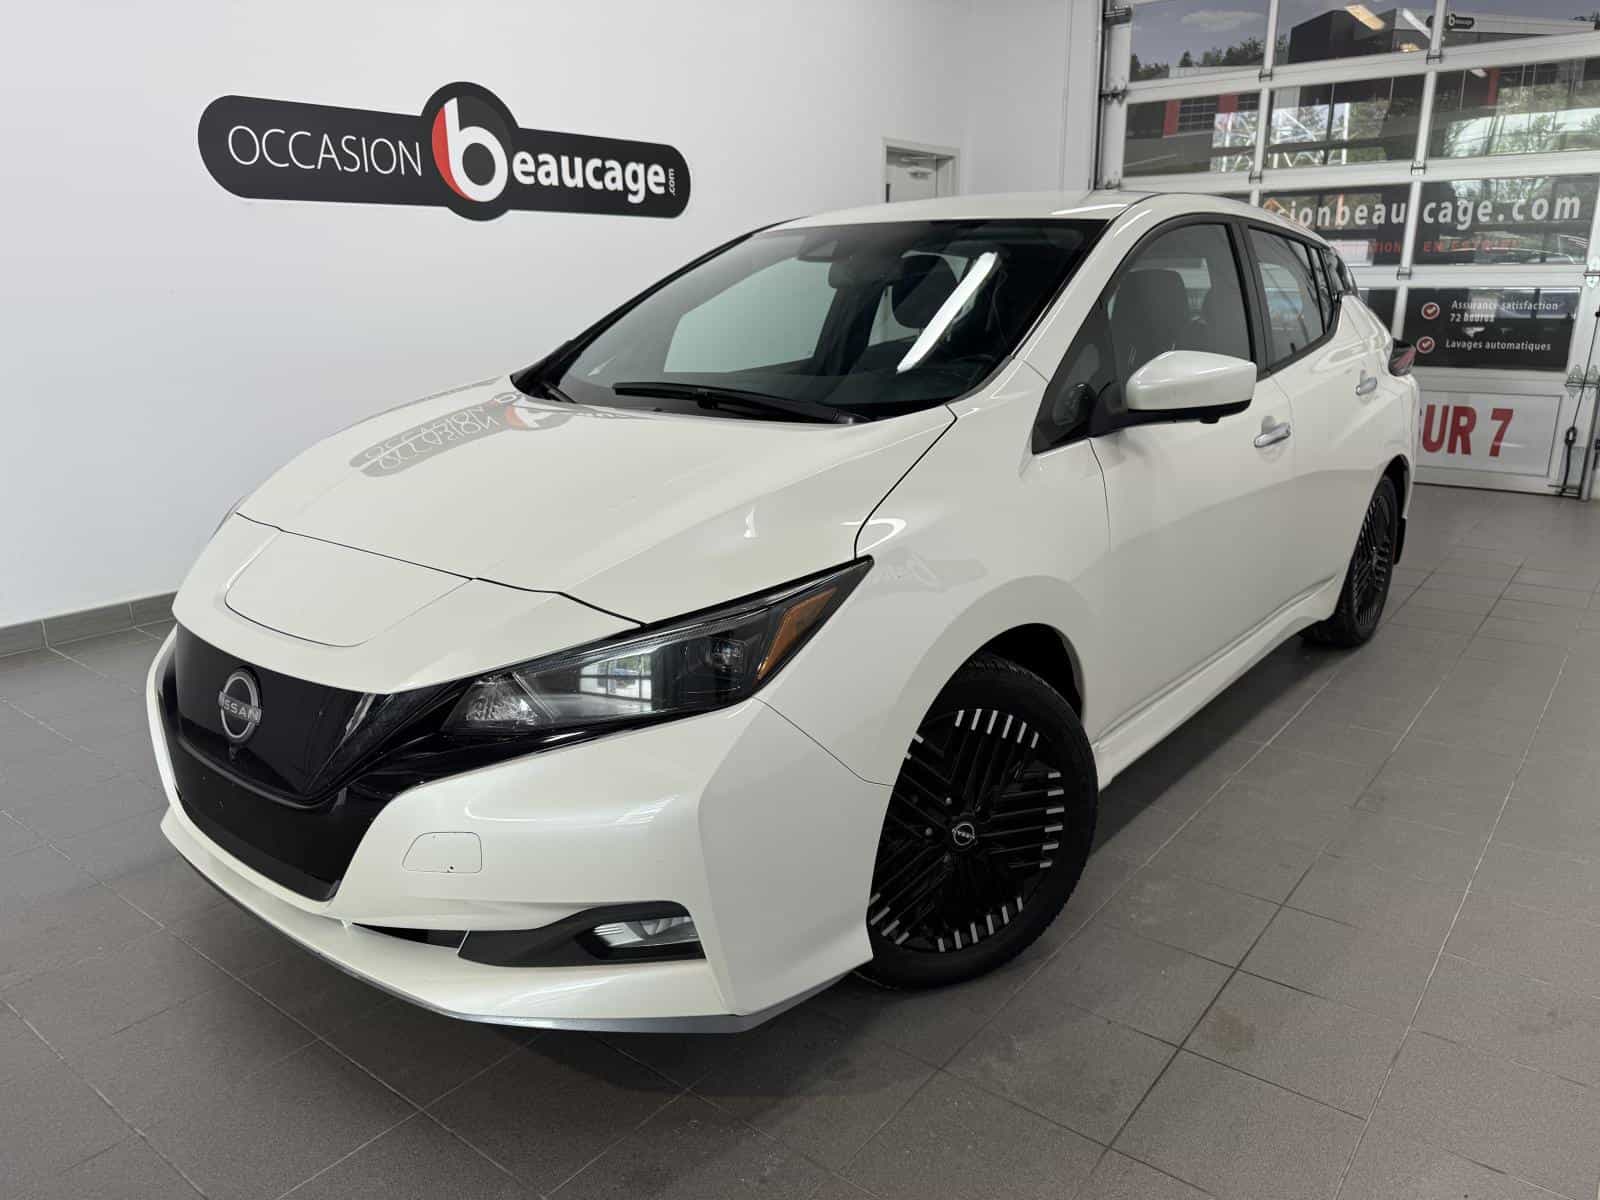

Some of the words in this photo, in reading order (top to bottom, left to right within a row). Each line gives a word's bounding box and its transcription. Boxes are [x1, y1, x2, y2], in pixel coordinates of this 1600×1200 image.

[228, 124, 422, 177] OCCASION
[1279, 193, 1582, 231] ionbeaucage.com
[1449, 313, 1462, 322] 72
[1501, 300, 1559, 312] satisfaction
[1446, 338, 1483, 352] Lavages
[1484, 339, 1552, 352] automatiques
[1420, 404, 1477, 456] UR
[1489, 408, 1515, 457] 7
